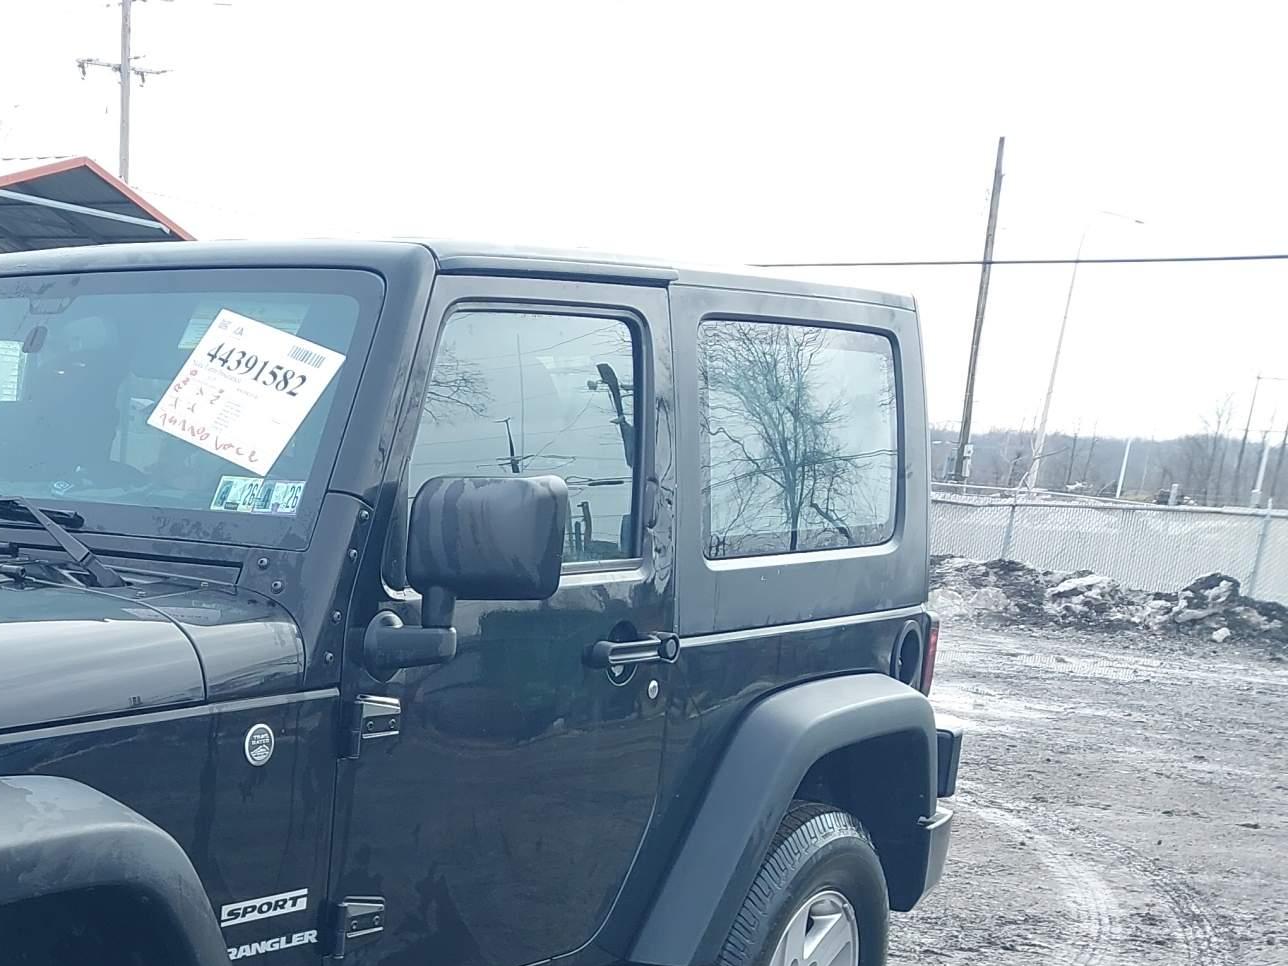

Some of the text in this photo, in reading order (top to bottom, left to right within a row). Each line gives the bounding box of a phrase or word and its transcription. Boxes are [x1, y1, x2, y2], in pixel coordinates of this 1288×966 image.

[207, 342, 306, 397] 44391582
[226, 895, 302, 921] SPORT
[227, 929, 318, 960] RANGLER
